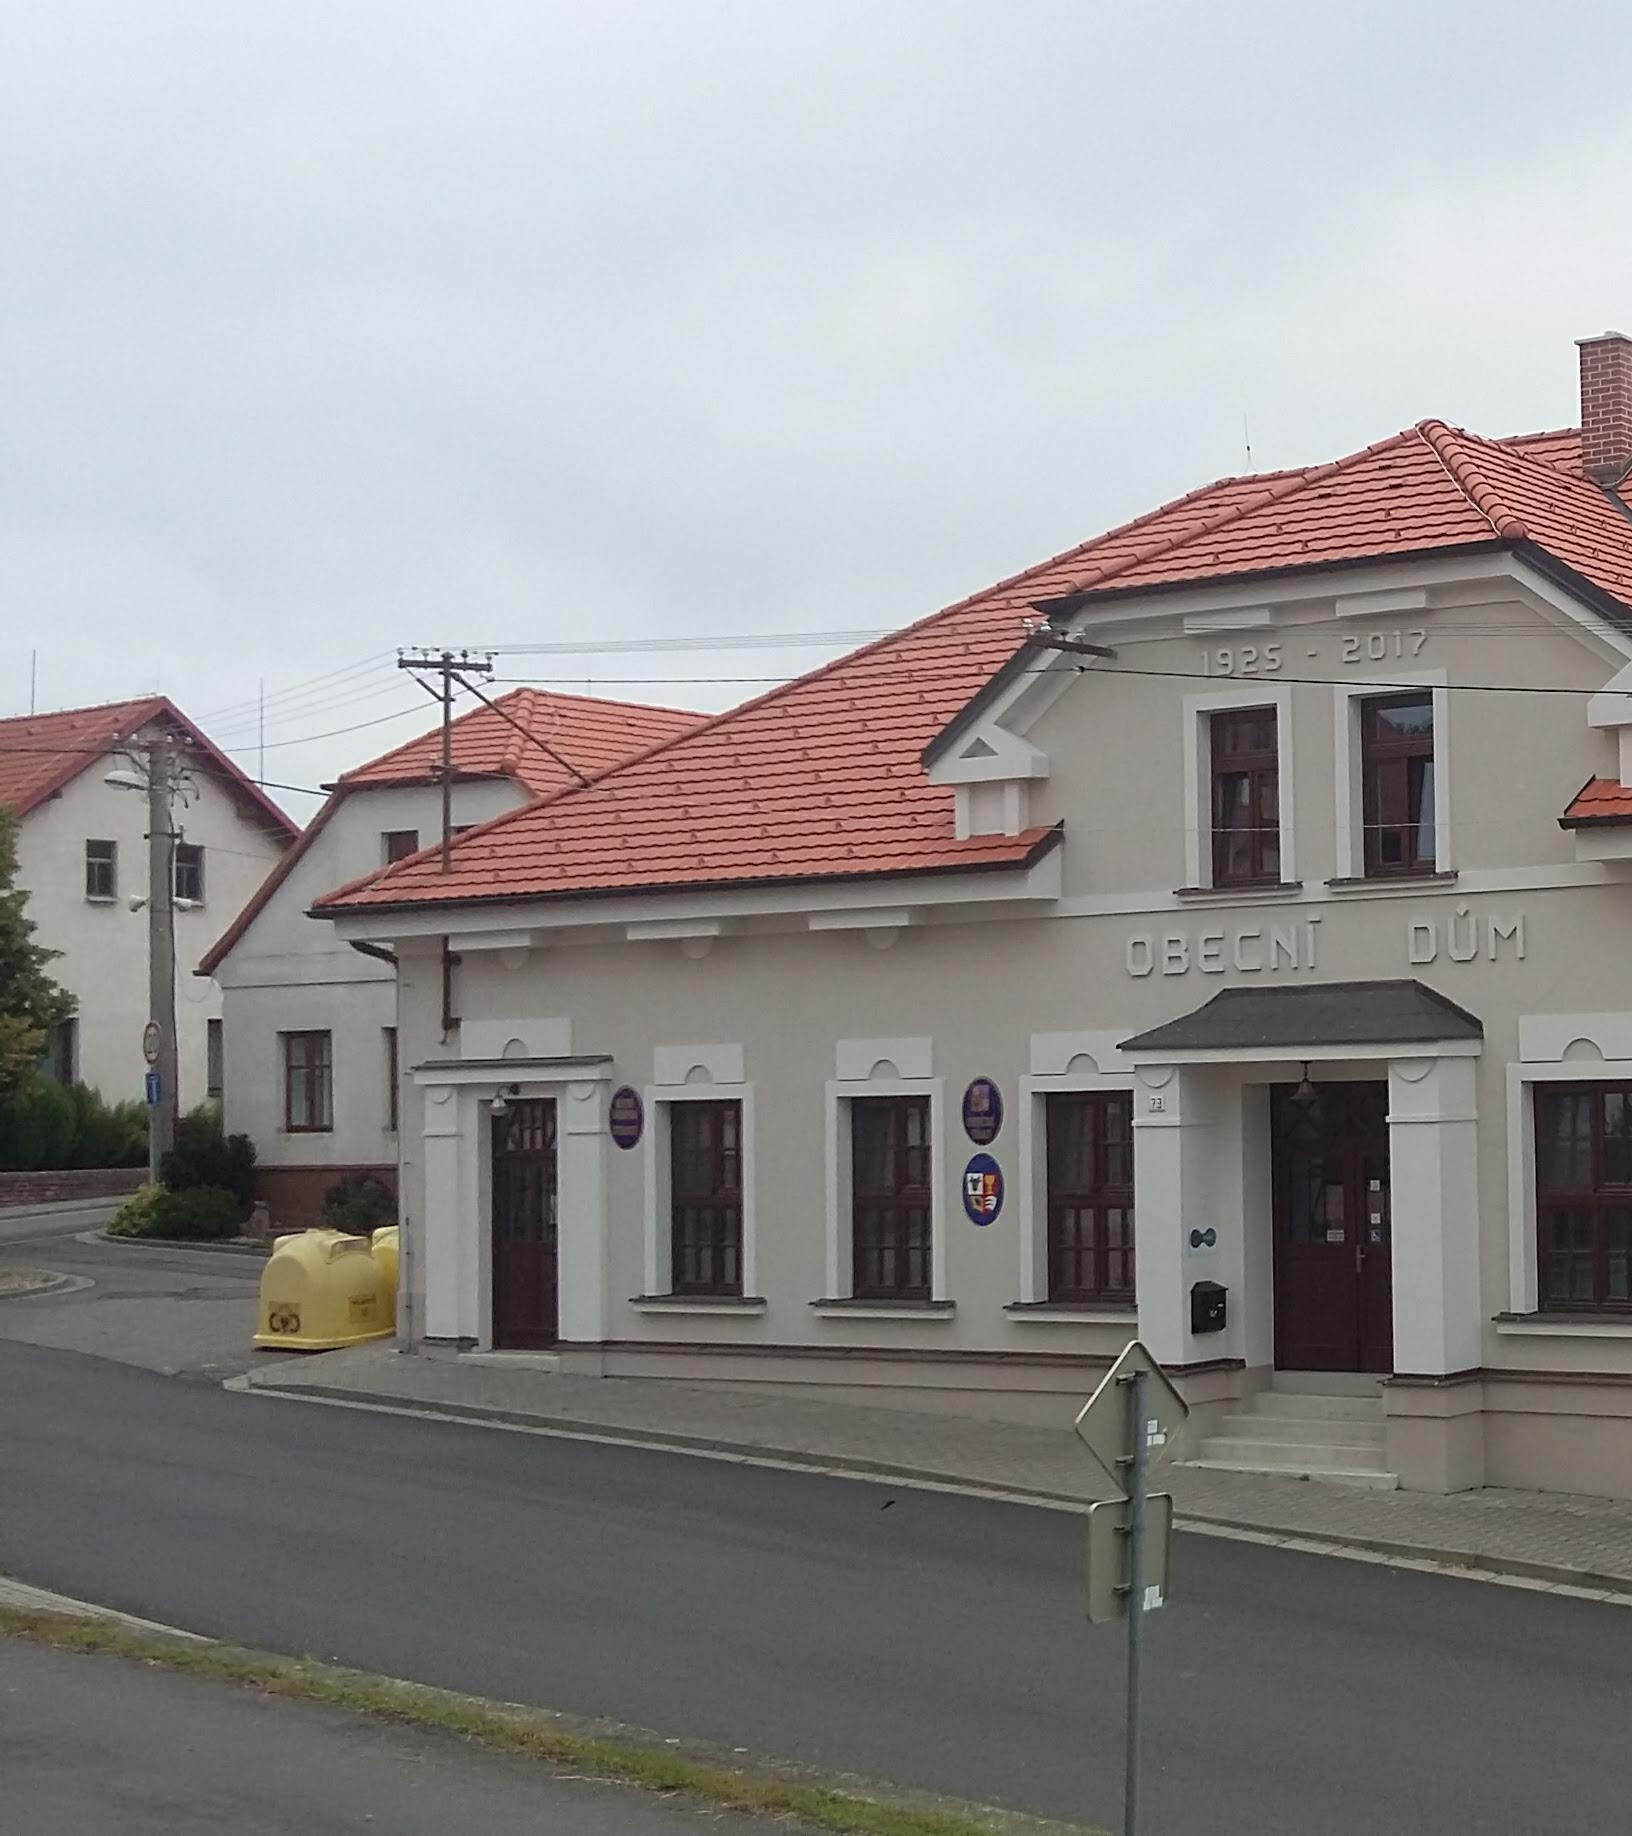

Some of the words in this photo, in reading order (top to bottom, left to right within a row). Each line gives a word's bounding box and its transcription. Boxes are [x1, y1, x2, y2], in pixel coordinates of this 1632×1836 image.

[1201, 644, 1282, 676] 1925
[1342, 629, 1427, 664] 2017
[1126, 913, 1322, 976] OBECNÍ
[1407, 904, 1526, 964] DŮM
